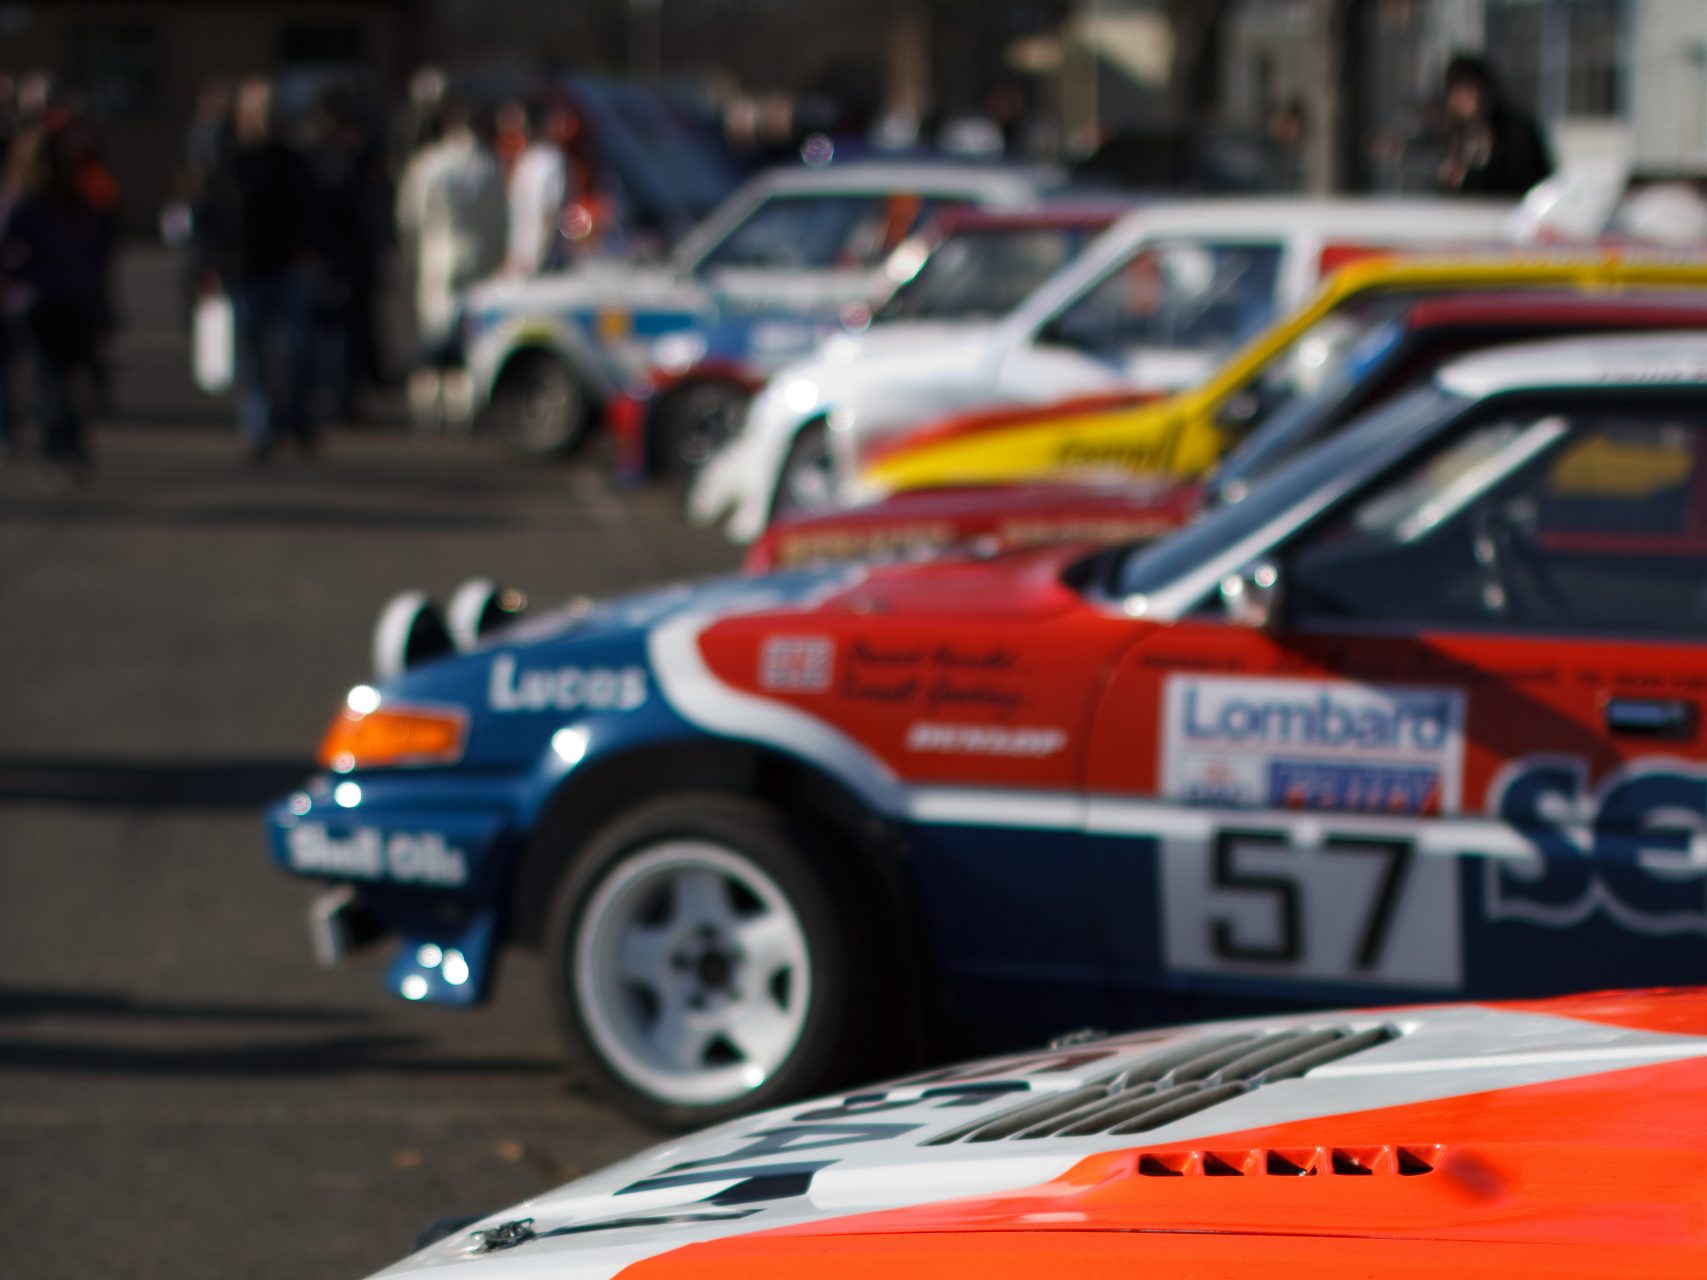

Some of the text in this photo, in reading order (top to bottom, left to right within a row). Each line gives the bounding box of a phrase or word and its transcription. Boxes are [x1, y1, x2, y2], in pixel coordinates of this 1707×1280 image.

[490, 655, 646, 711] Lucas
[1184, 685, 1449, 750] Lombard
[288, 824, 466, 886] Shell Oils
[1208, 827, 1416, 972] 57
